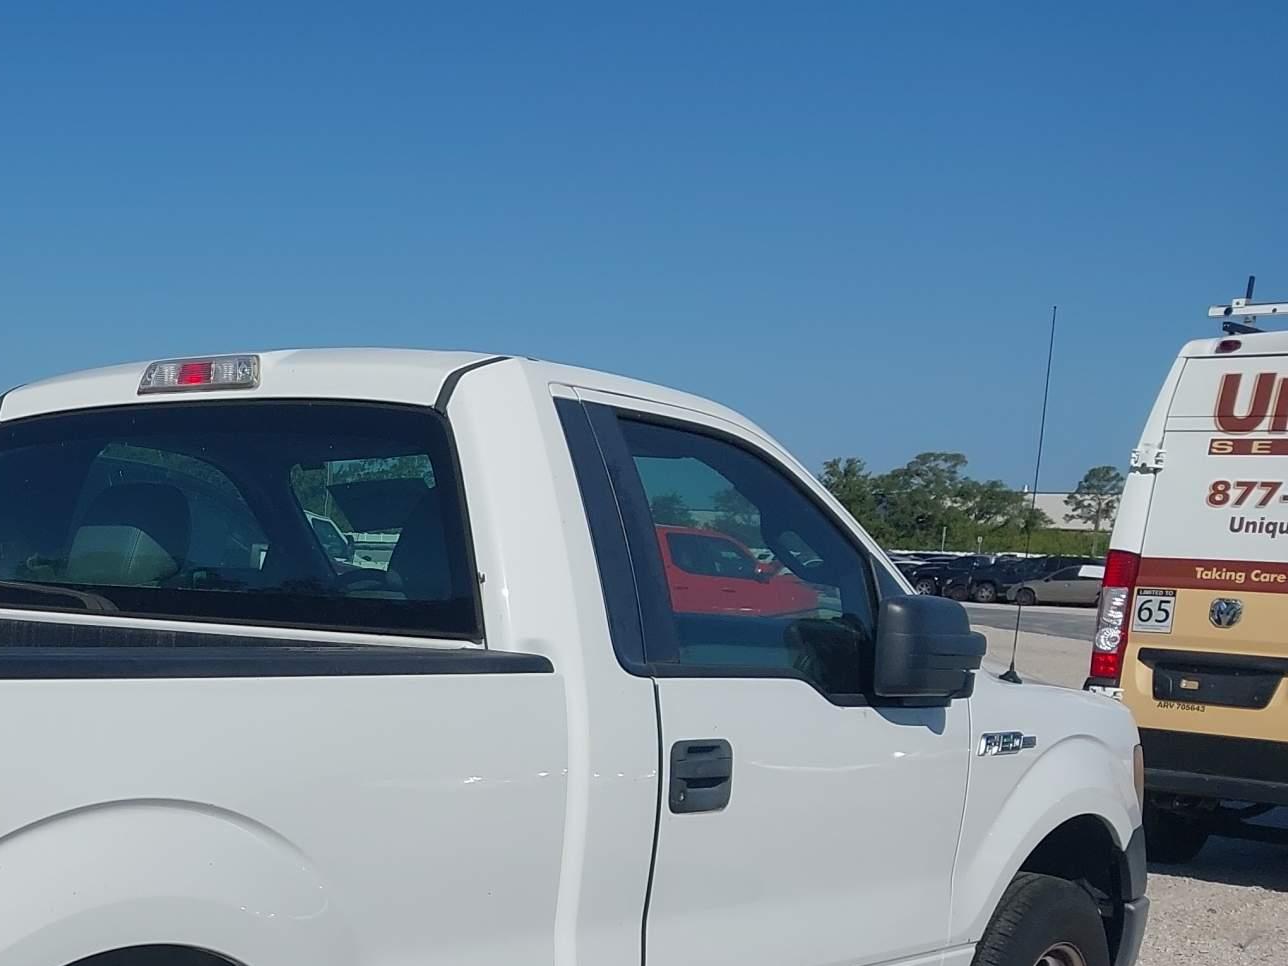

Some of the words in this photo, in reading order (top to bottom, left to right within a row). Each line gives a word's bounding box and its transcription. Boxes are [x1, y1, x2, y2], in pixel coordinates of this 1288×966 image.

[1195, 567, 1245, 584] Taking
[1250, 569, 1287, 583] Care
[1137, 599, 1171, 624] 65
